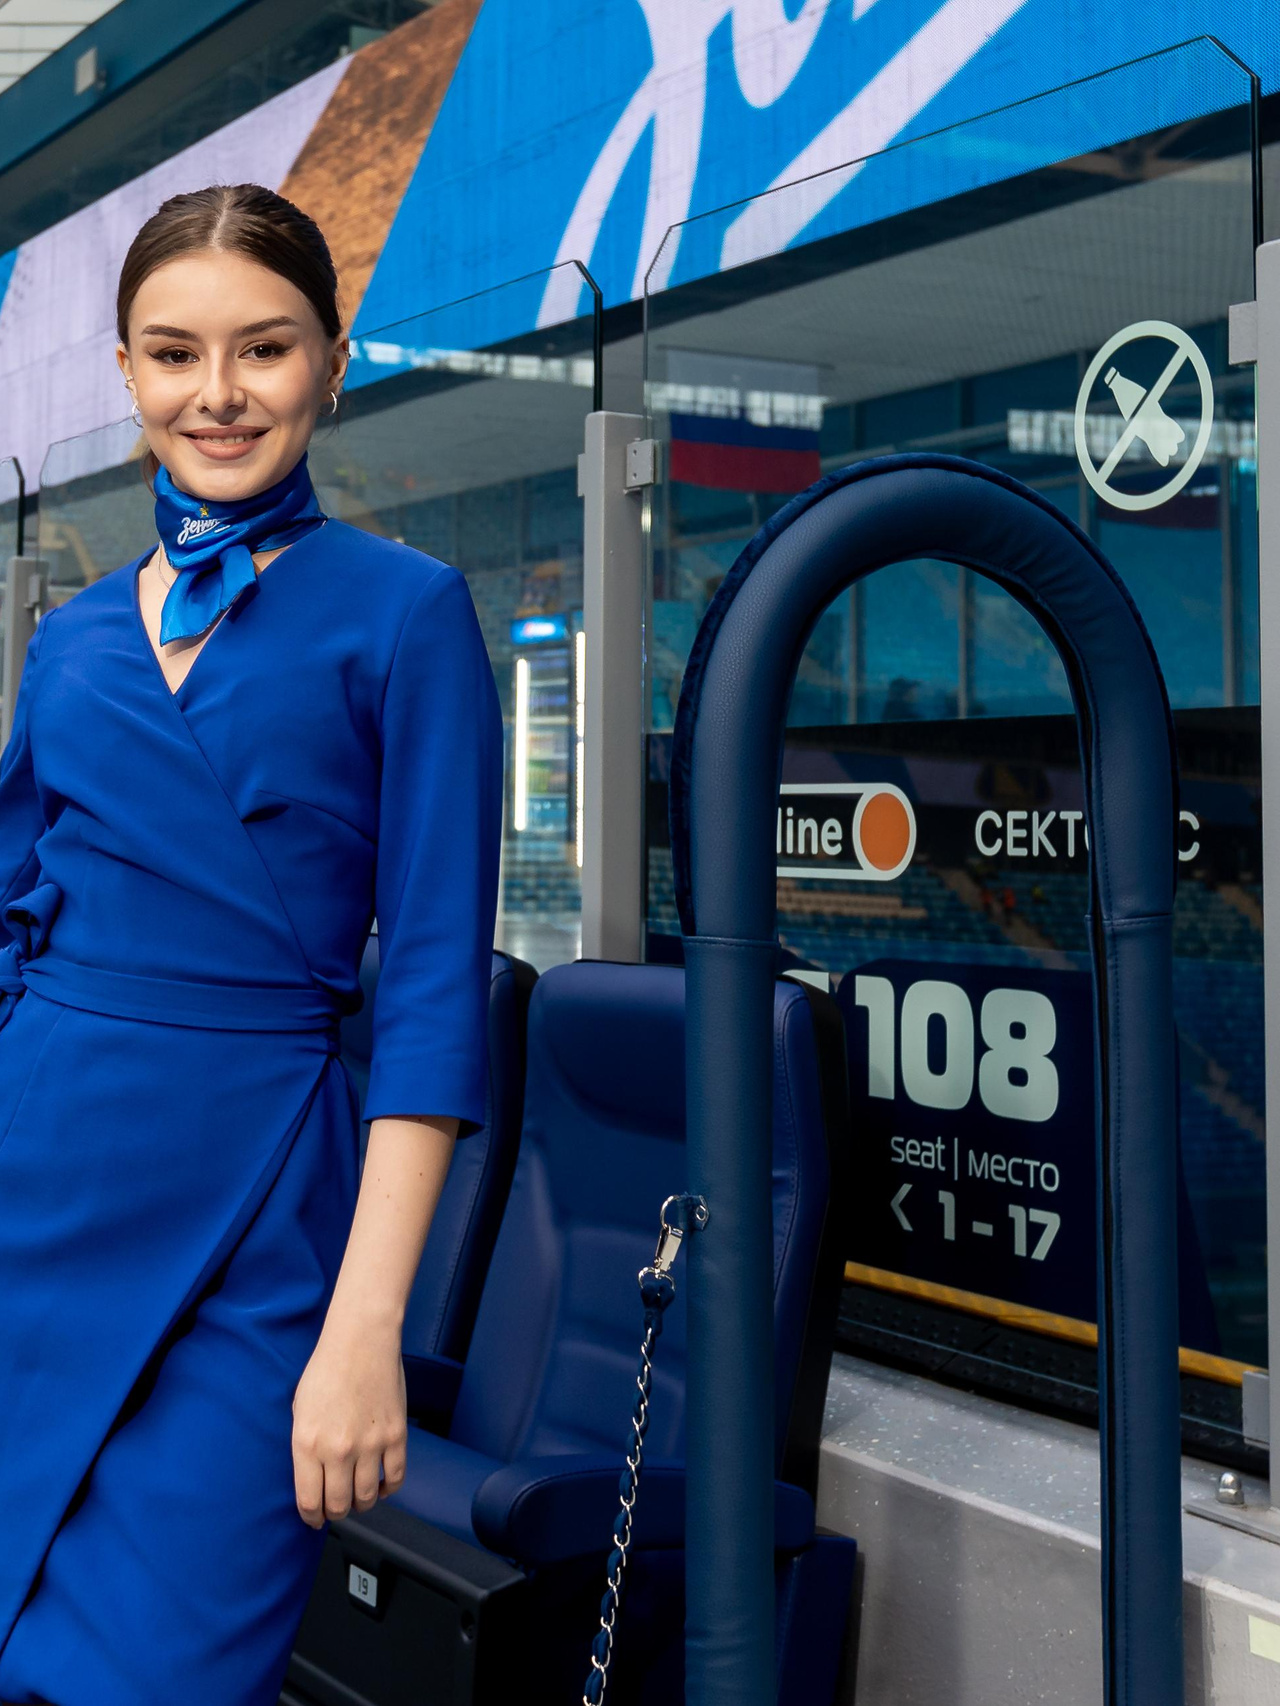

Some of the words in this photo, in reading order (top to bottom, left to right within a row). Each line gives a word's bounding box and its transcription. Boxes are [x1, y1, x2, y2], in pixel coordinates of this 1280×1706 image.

[975, 810, 1089, 857] СЕКТ
[855, 975, 1059, 1122] 108
[891, 1136, 945, 1171] seat
[968, 1149, 1060, 1192] место
[938, 1190, 955, 1241] 1
[1008, 1204, 1060, 1261] 17
[358, 1574, 368, 1596] 19
